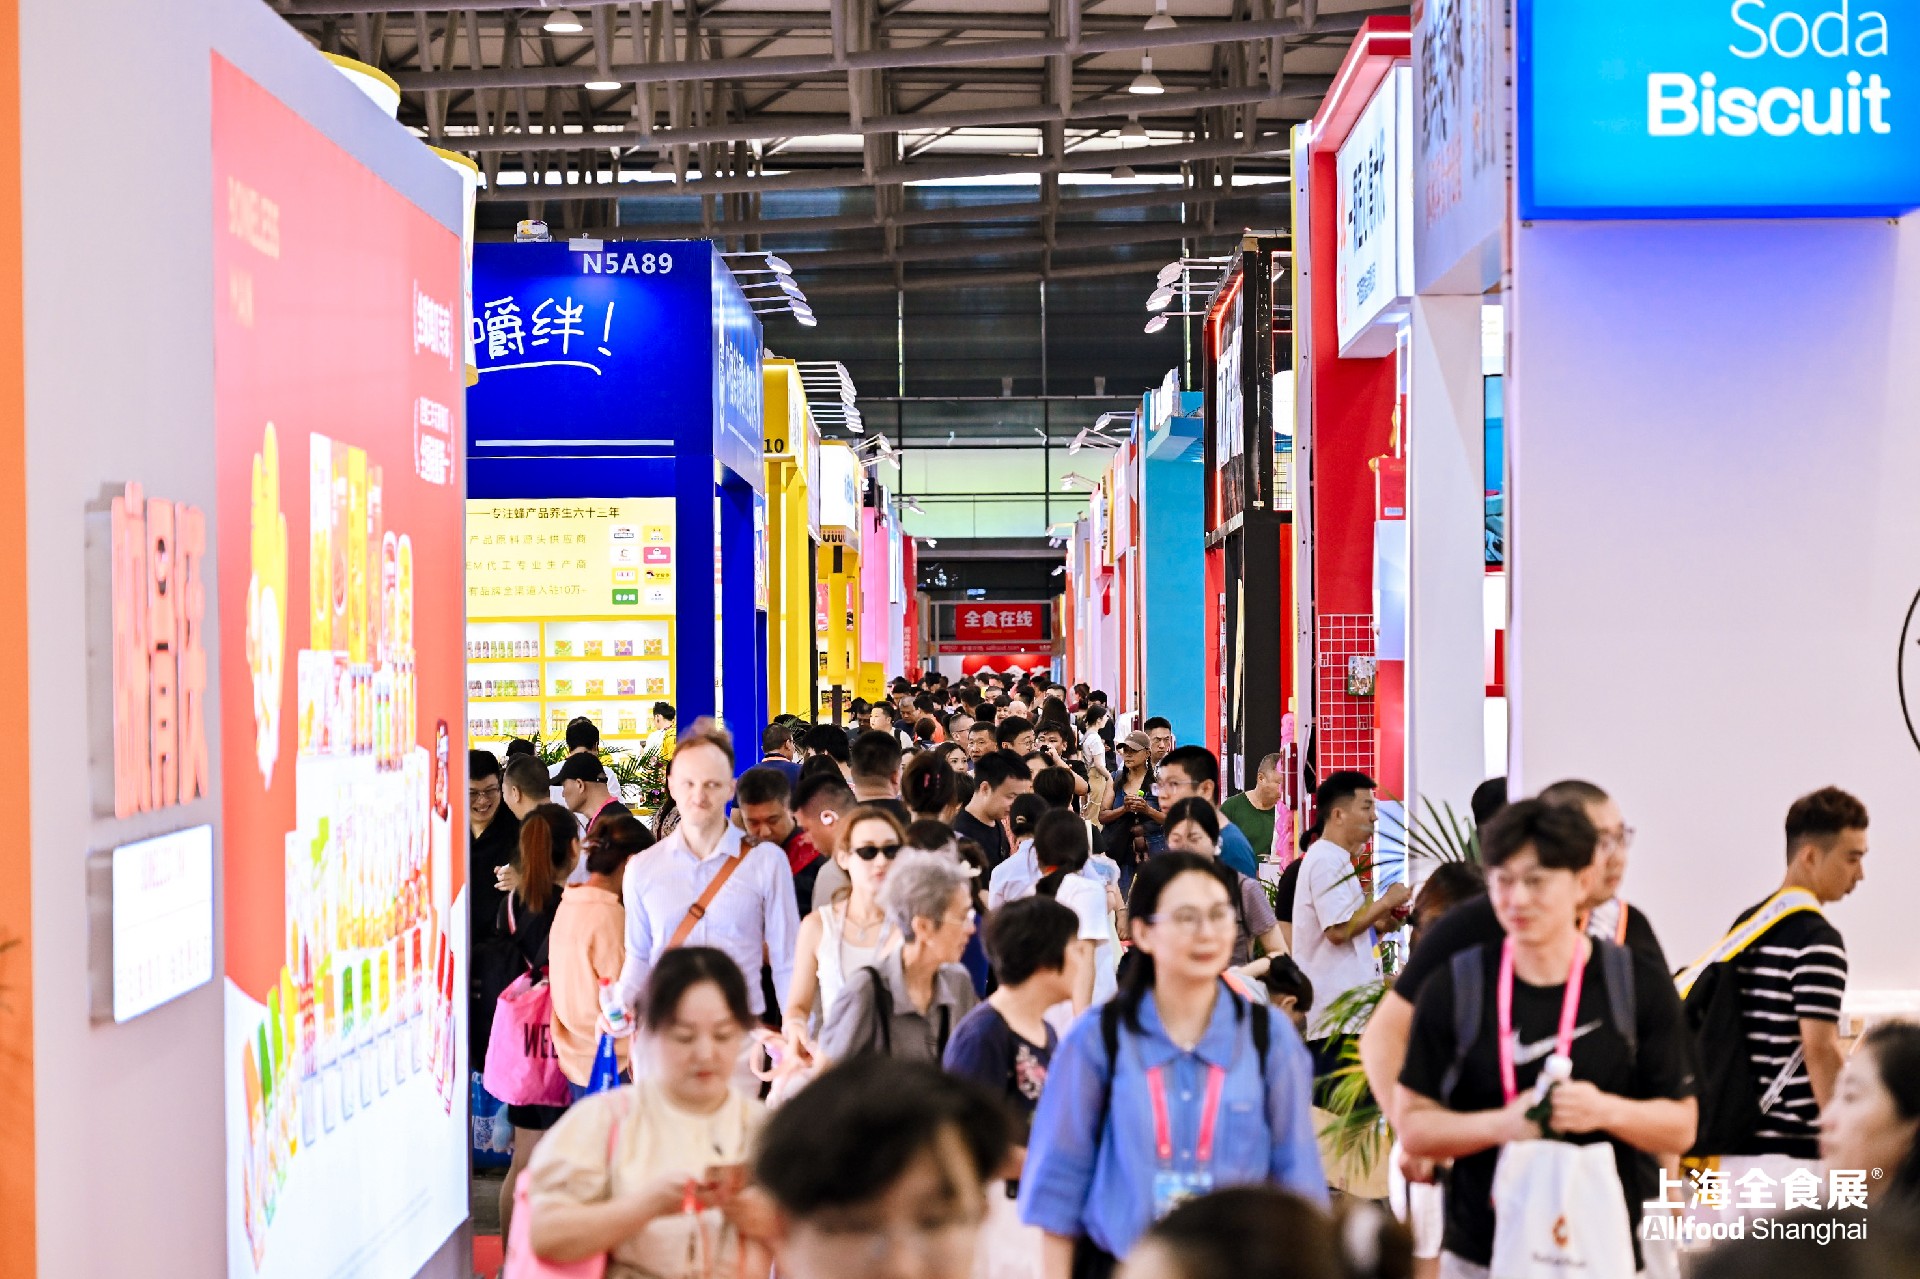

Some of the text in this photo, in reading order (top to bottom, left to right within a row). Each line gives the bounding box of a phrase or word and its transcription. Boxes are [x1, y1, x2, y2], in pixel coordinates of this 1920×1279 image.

[1728, 0, 1889, 59] Soda
[1646, 70, 1892, 137] Biscuit
[582, 252, 674, 275] N5A89
[964, 610, 1033, 628] 全食在线
